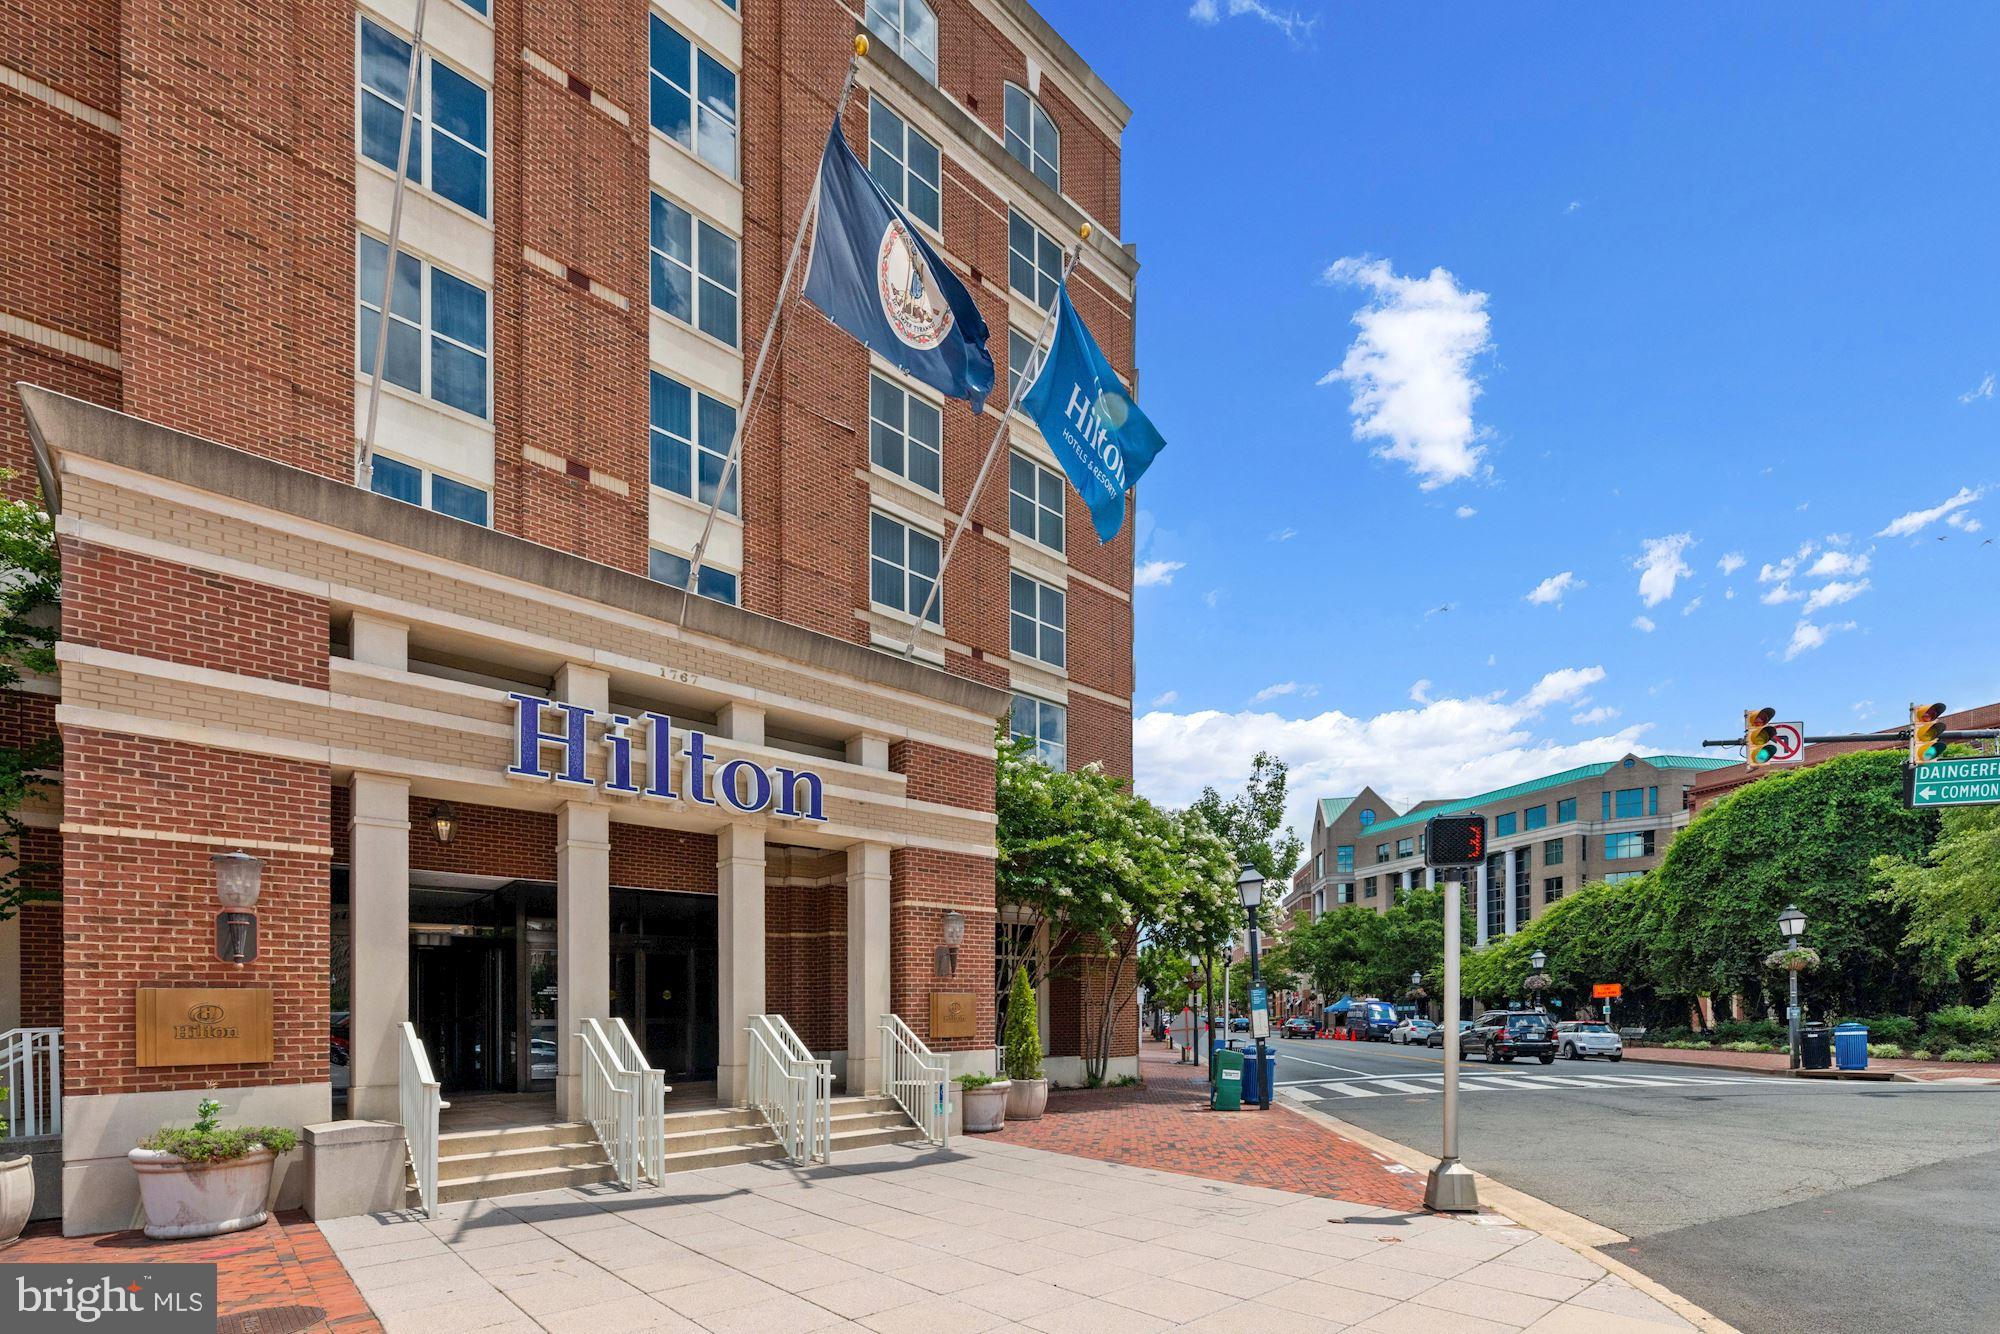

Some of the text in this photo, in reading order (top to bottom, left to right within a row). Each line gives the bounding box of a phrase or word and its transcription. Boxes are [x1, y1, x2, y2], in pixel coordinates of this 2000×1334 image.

[1065, 382, 1126, 489] Hilton
[1062, 428, 1118, 500] HOTELS & RESORTS
[660, 667, 699, 685] 1767
[506, 691, 829, 823] Hilton
[1941, 783, 1999, 799] COMMON
[1467, 825, 1482, 859] 3
[174, 1024, 240, 1040] Hilton
